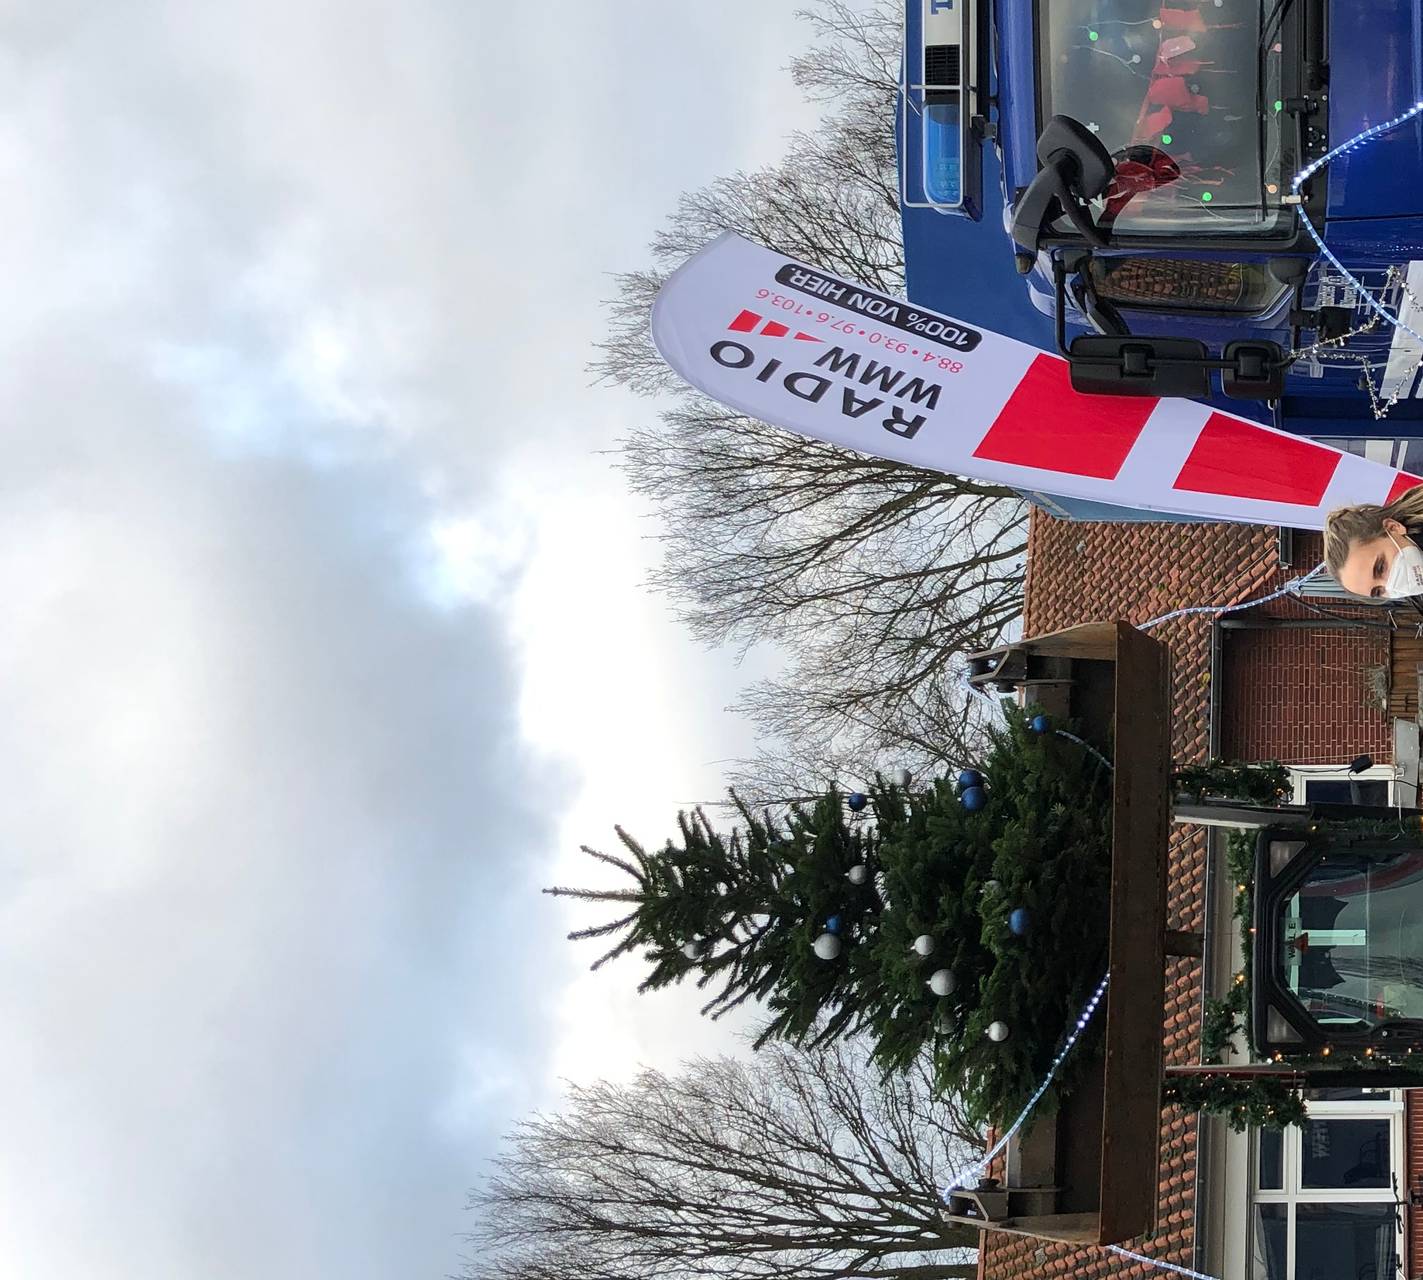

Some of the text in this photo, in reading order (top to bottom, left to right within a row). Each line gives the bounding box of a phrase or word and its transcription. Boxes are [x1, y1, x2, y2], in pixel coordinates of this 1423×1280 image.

[790, 267, 968, 346] 100% VON HIER.
[710, 340, 927, 439] RADIO
[813, 346, 942, 410] WMW
